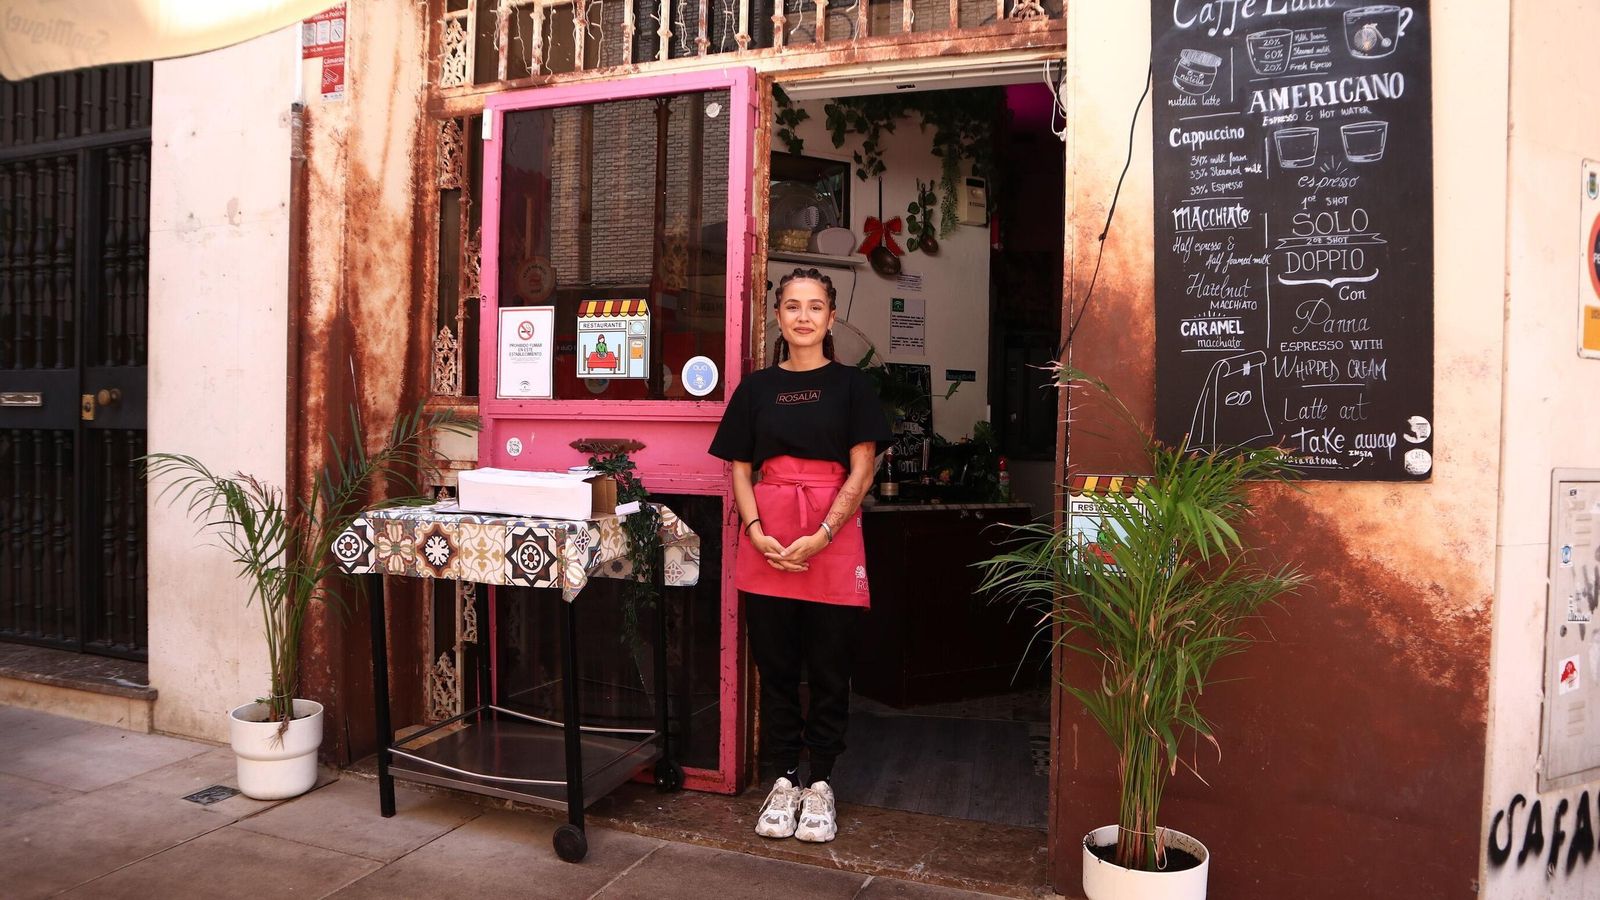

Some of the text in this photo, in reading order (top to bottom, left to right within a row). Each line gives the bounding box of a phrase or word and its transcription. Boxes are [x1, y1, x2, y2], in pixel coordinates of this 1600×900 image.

[1263, 38, 1281, 47] 20%
[1264, 49, 1283, 60] 60%
[1263, 63, 1282, 72] 20%
[1245, 71, 1405, 115] AMERICANO
[1168, 94, 1221, 107] nutella latte
[1319, 109, 1335, 119] HOT
[1169, 126, 1246, 151] Cappuccino
[1190, 168, 1208, 180] 33%
[1190, 184, 1209, 196] 33%
[1325, 196, 1349, 206] SHOT
[1292, 208, 1369, 237] SOLO
[1326, 236, 1349, 245] SHOT
[1285, 248, 1364, 274] DOPPIO
[1339, 285, 1367, 301] Con
[1292, 298, 1370, 335] Panna
[1180, 320, 1245, 337] CARAMEL
[1280, 339, 1383, 352] ESPRESSO WITH
[1347, 358, 1388, 381] CREAM
[1284, 393, 1373, 422] Latte art
[1354, 432, 1398, 461] away
